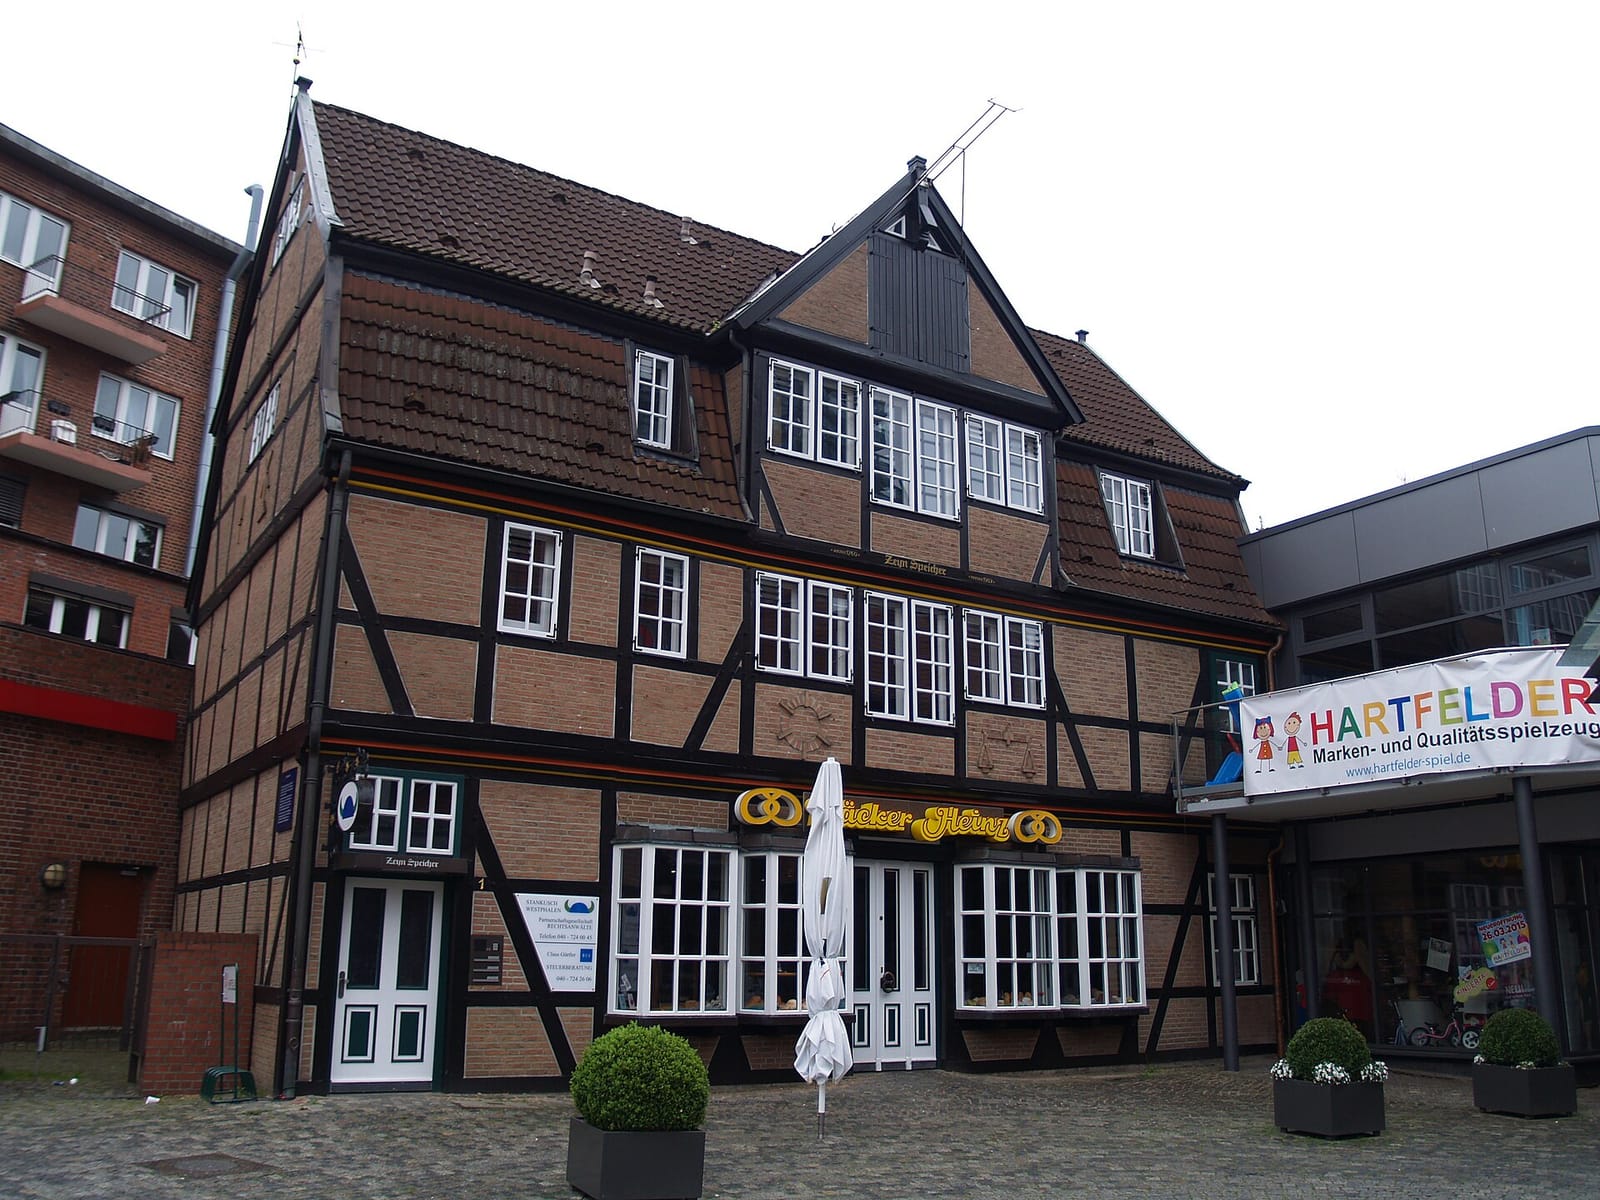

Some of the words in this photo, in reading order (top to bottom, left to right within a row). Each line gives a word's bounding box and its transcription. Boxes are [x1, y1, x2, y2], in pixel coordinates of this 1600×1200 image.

[910, 559, 947, 576] Speicher
[1310, 678, 1597, 745] HARTFELDER
[1313, 744, 1377, 764] Marken-
[1381, 735, 1412, 754] und
[1417, 721, 1600, 748] Qualitätsspielzeug
[1345, 752, 1471, 777] www.hartfelder-spiel.de
[807, 800, 913, 831] äcker
[911, 806, 1011, 842] Heinz
[407, 858, 440, 868] Speicher
[478, 878, 485, 890] 1
[1482, 921, 1526, 940] 26.03.2015
